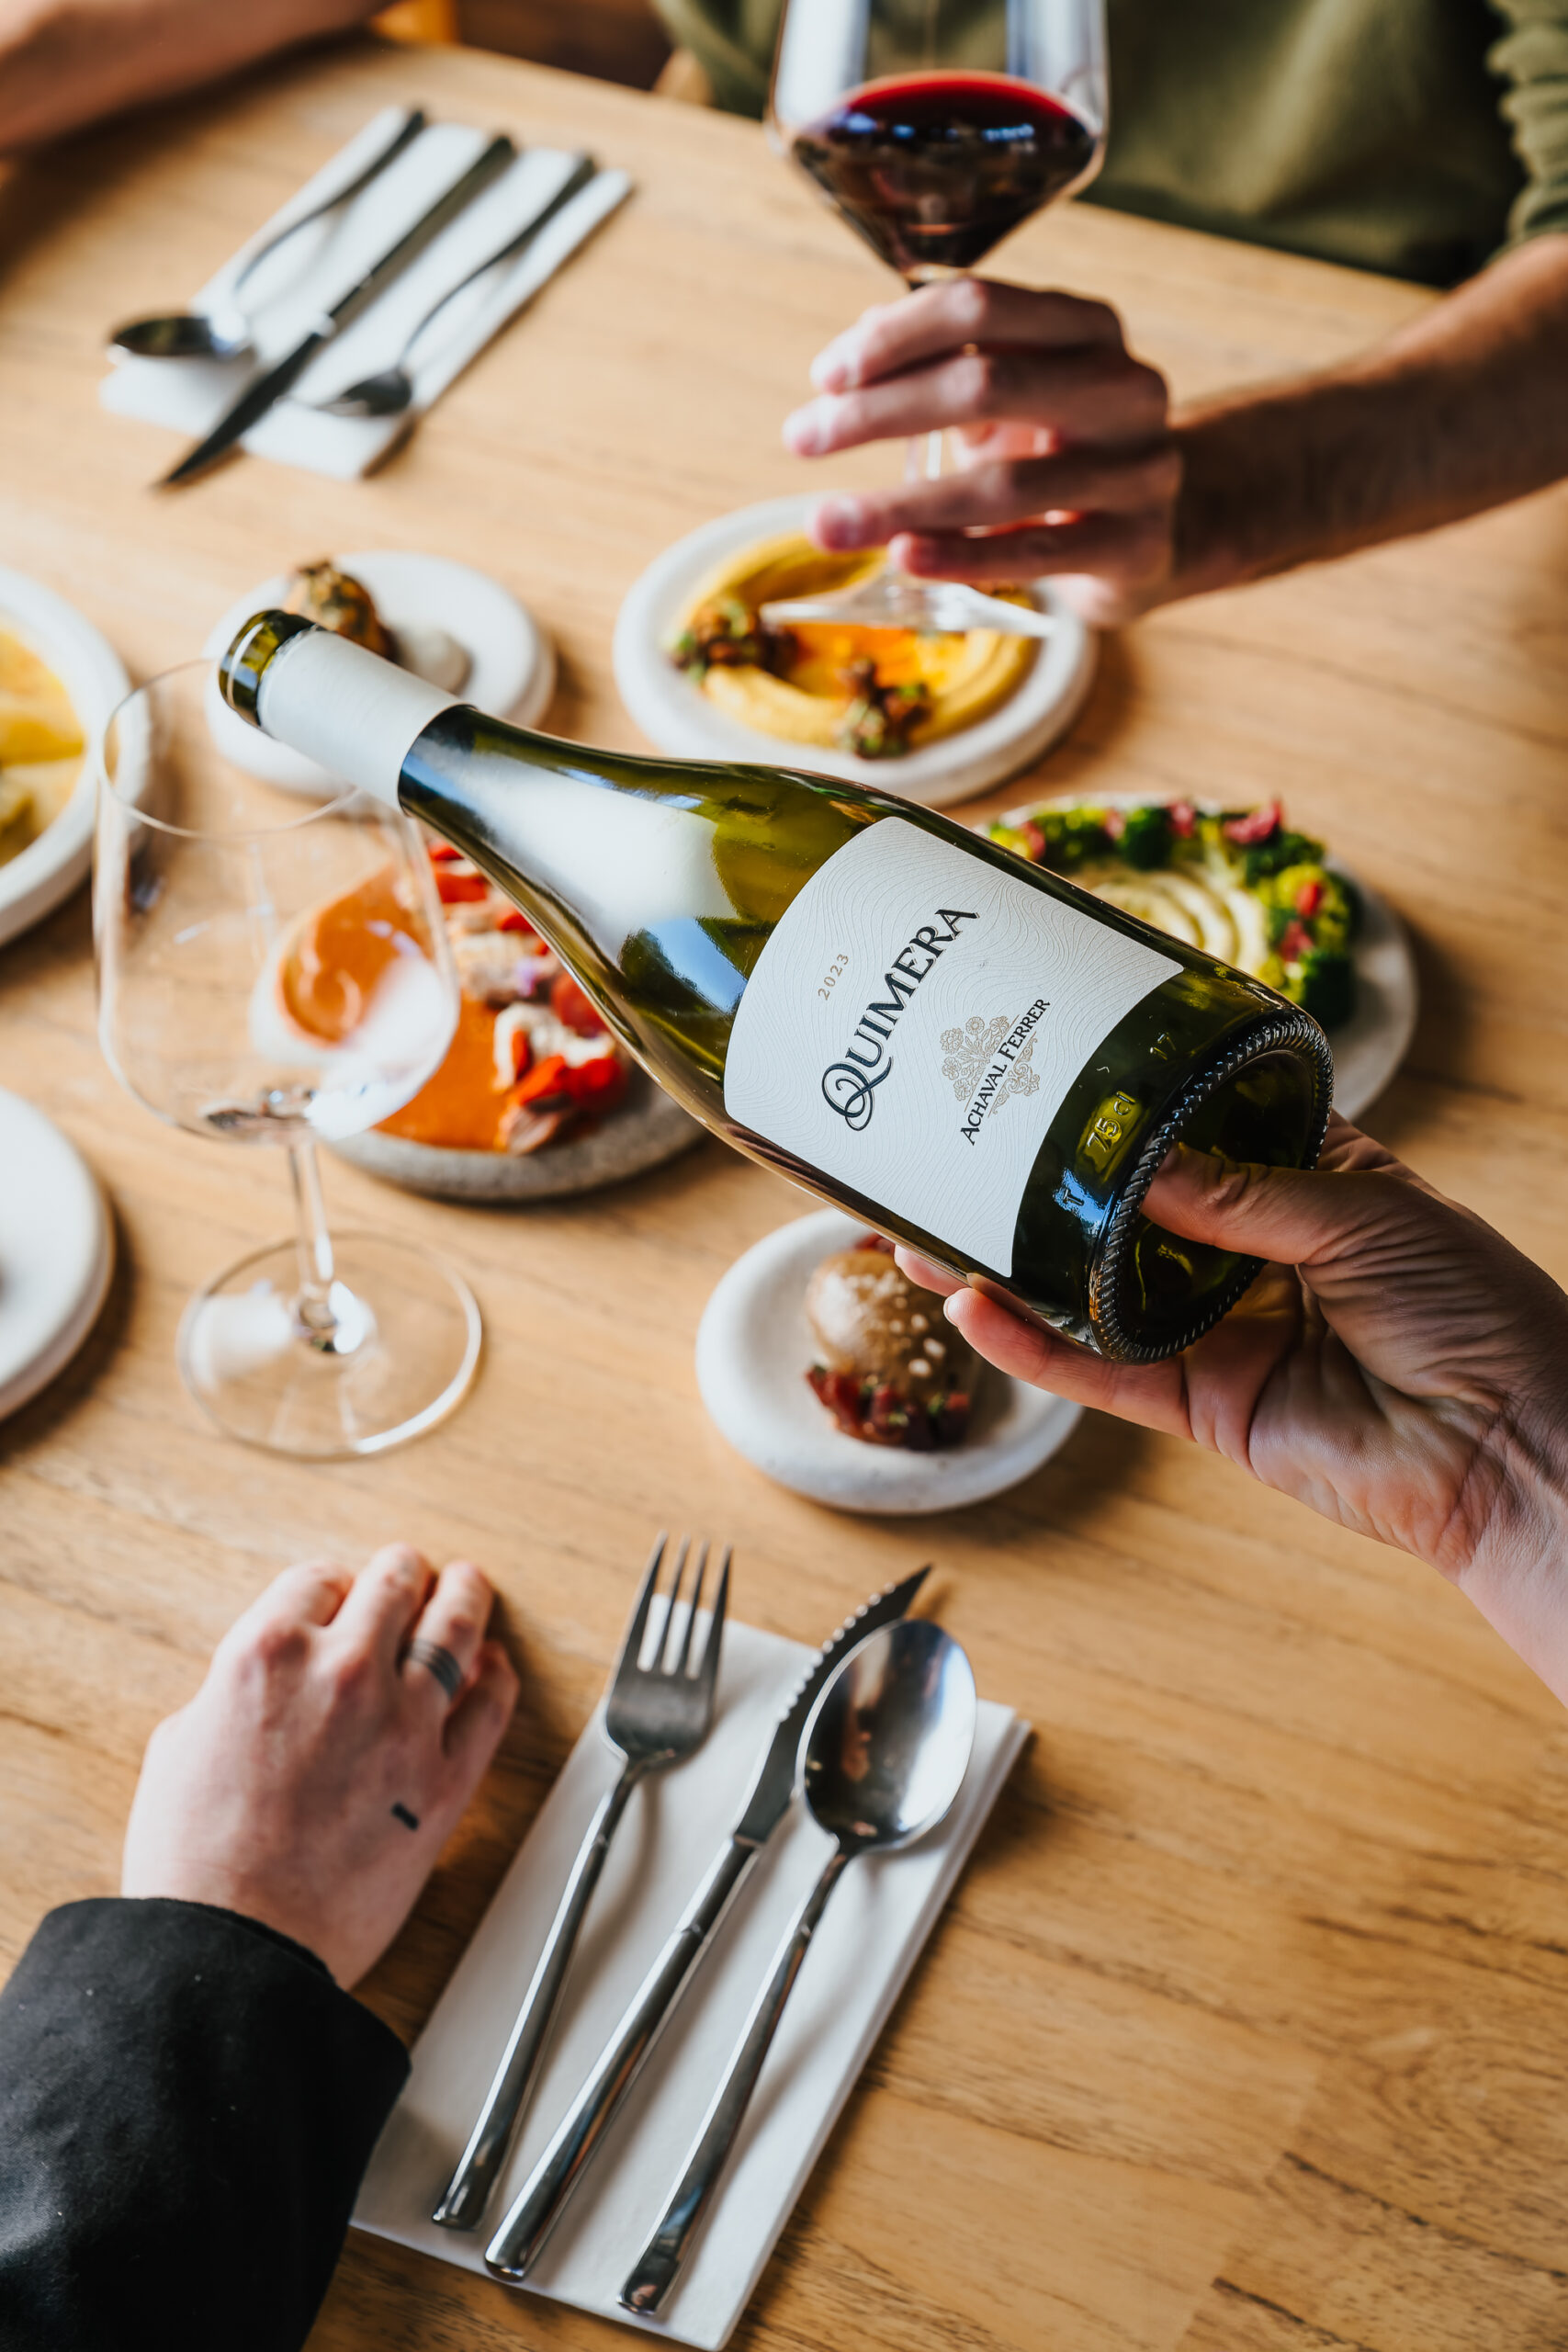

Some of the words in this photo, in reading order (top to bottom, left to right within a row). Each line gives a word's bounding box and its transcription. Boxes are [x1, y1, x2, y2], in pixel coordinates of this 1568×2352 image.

[818, 954, 849, 1001] 2023
[822, 909, 979, 1131] QUIMERA
[961, 1063, 1008, 1145] ACHAVAL
[998, 999, 1051, 1062] FERRER
[1087, 1117, 1122, 1153] 75
